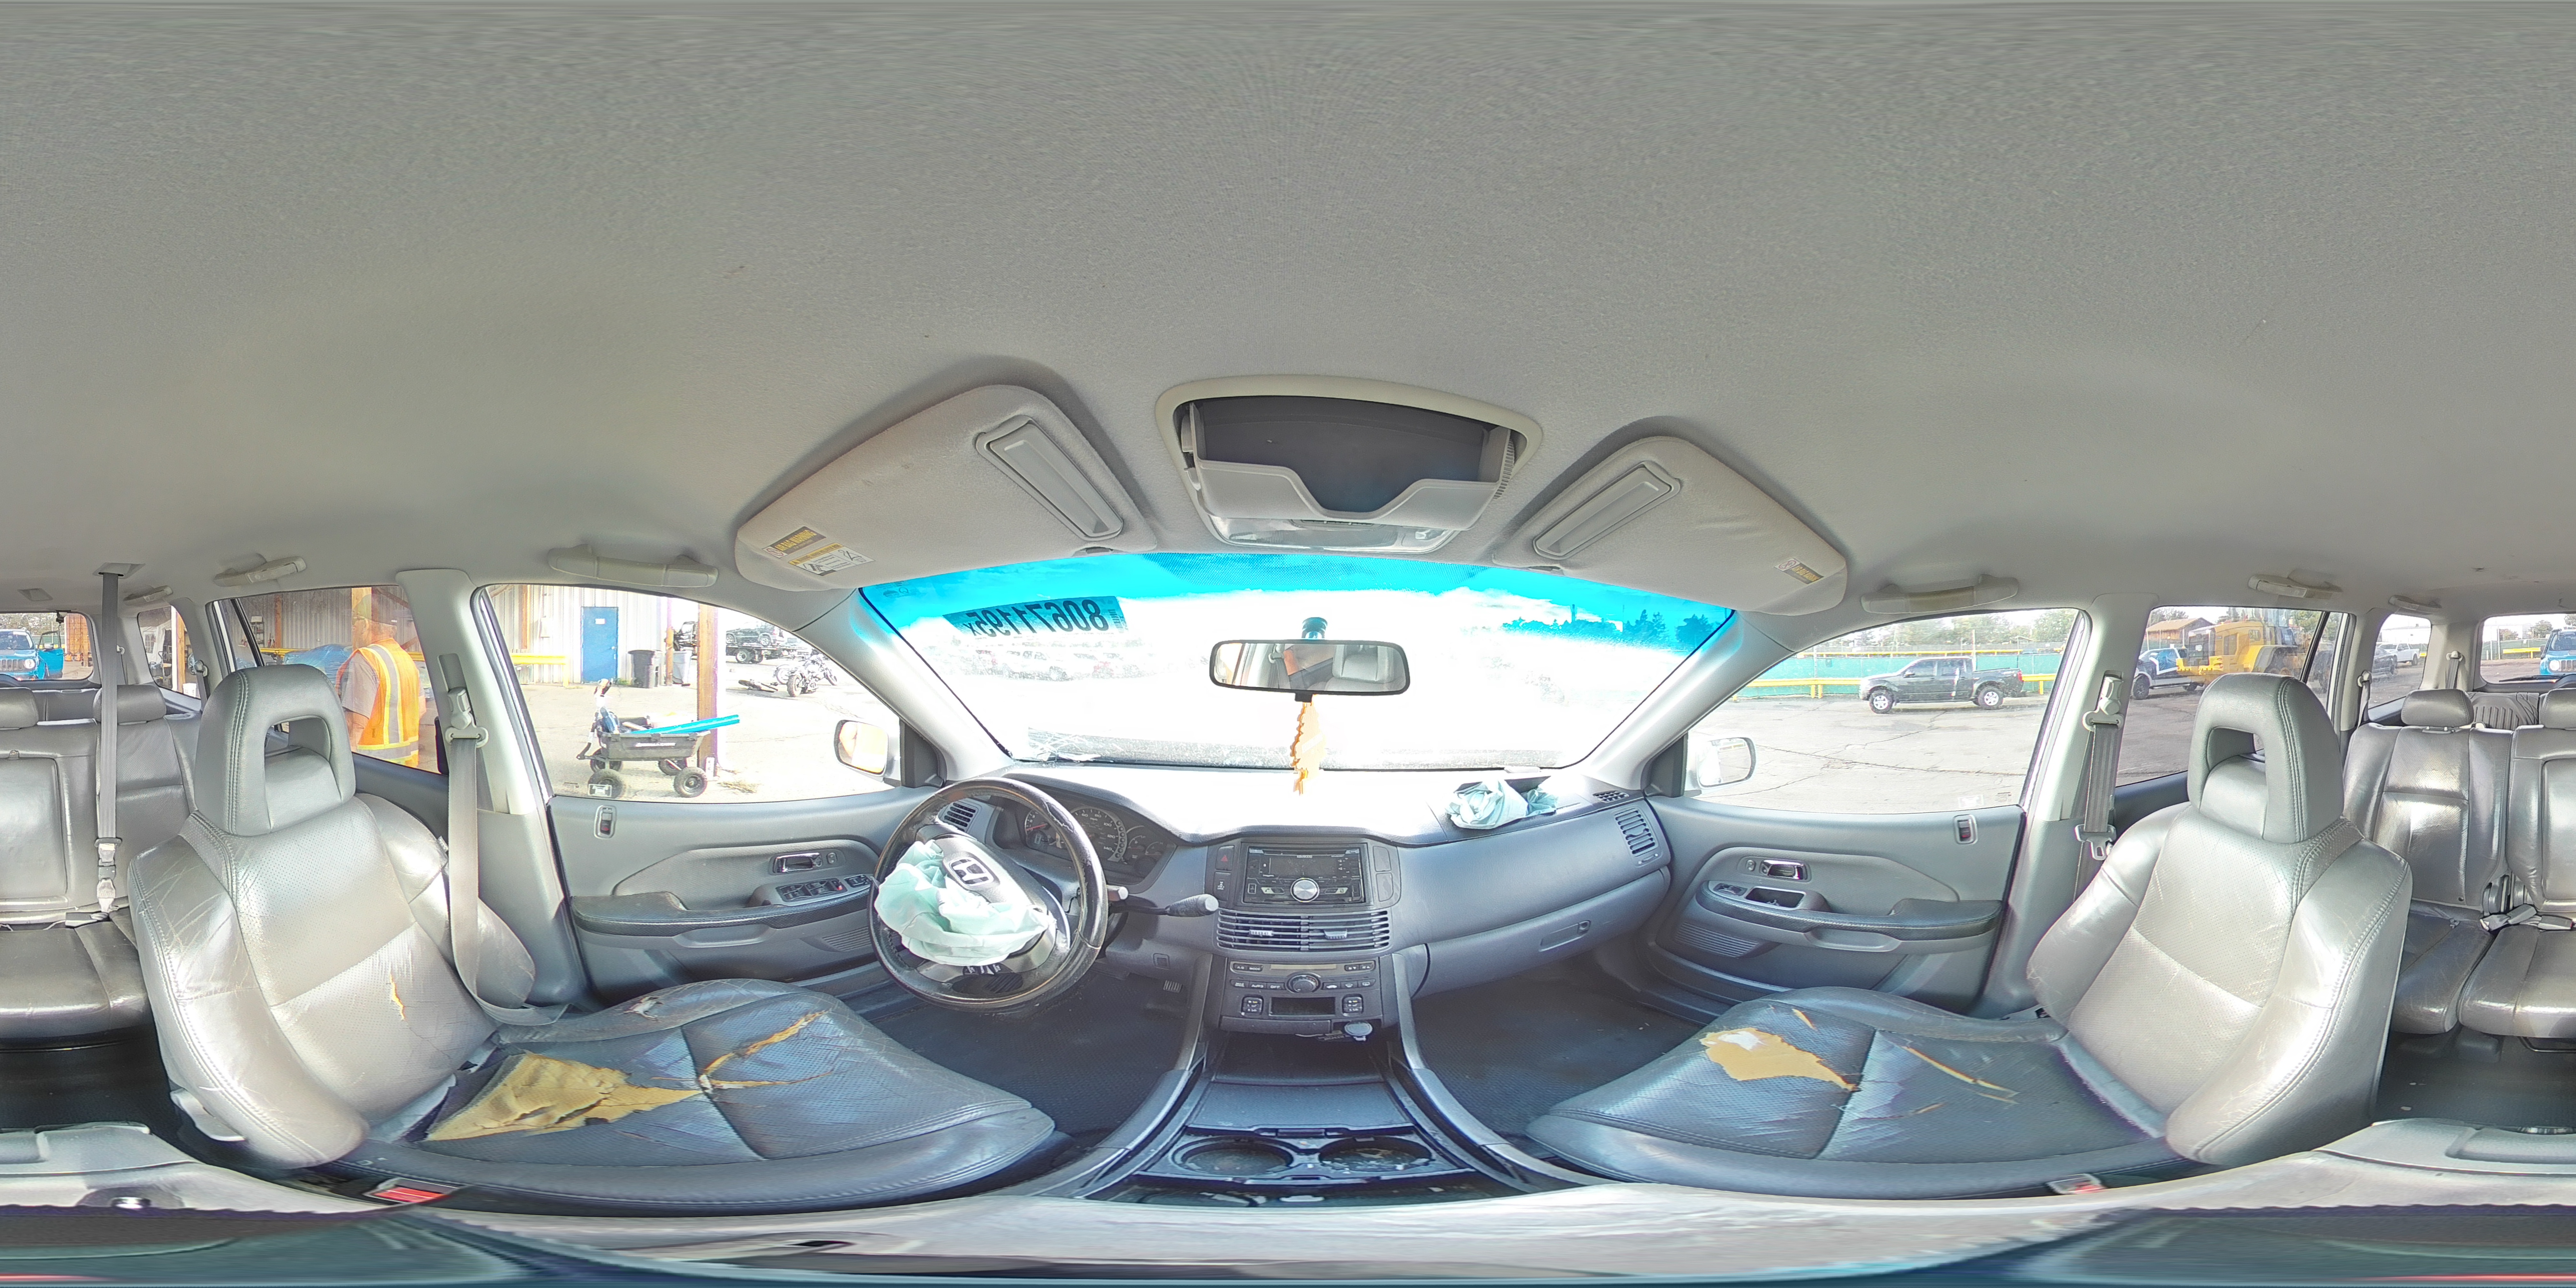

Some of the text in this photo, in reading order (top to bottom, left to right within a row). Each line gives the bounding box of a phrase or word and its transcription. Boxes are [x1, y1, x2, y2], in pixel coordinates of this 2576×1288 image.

[781, 539, 797, 549] BAG
[790, 529, 816, 544] WARNING
[2249, 630, 2258, 638] CAT
